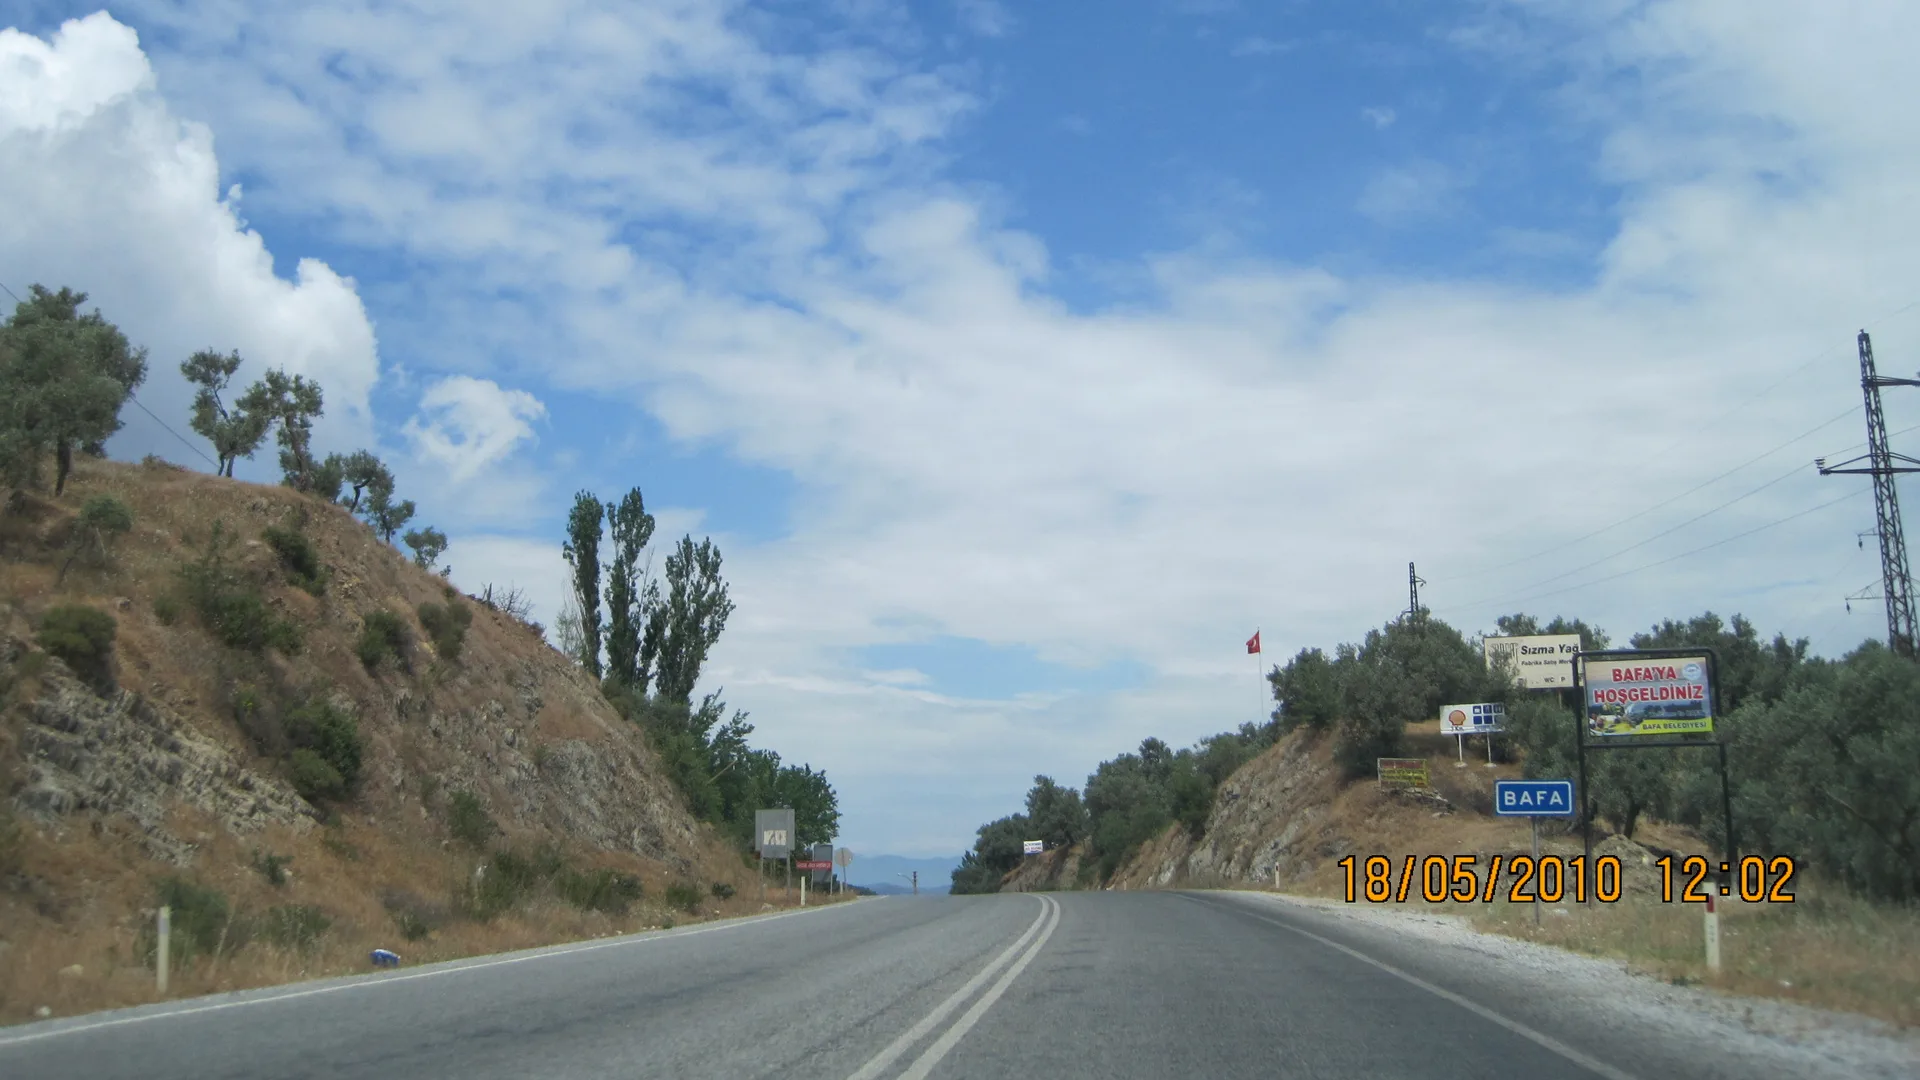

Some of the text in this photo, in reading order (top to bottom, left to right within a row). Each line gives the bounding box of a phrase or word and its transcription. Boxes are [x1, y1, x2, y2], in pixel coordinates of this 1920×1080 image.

[1521, 645, 1554, 655] Sızma
[1612, 666, 1677, 682] BAFA'YA
[1593, 683, 1703, 704] HOŞGELDİNİZ
[1504, 790, 1563, 806] BAFA
